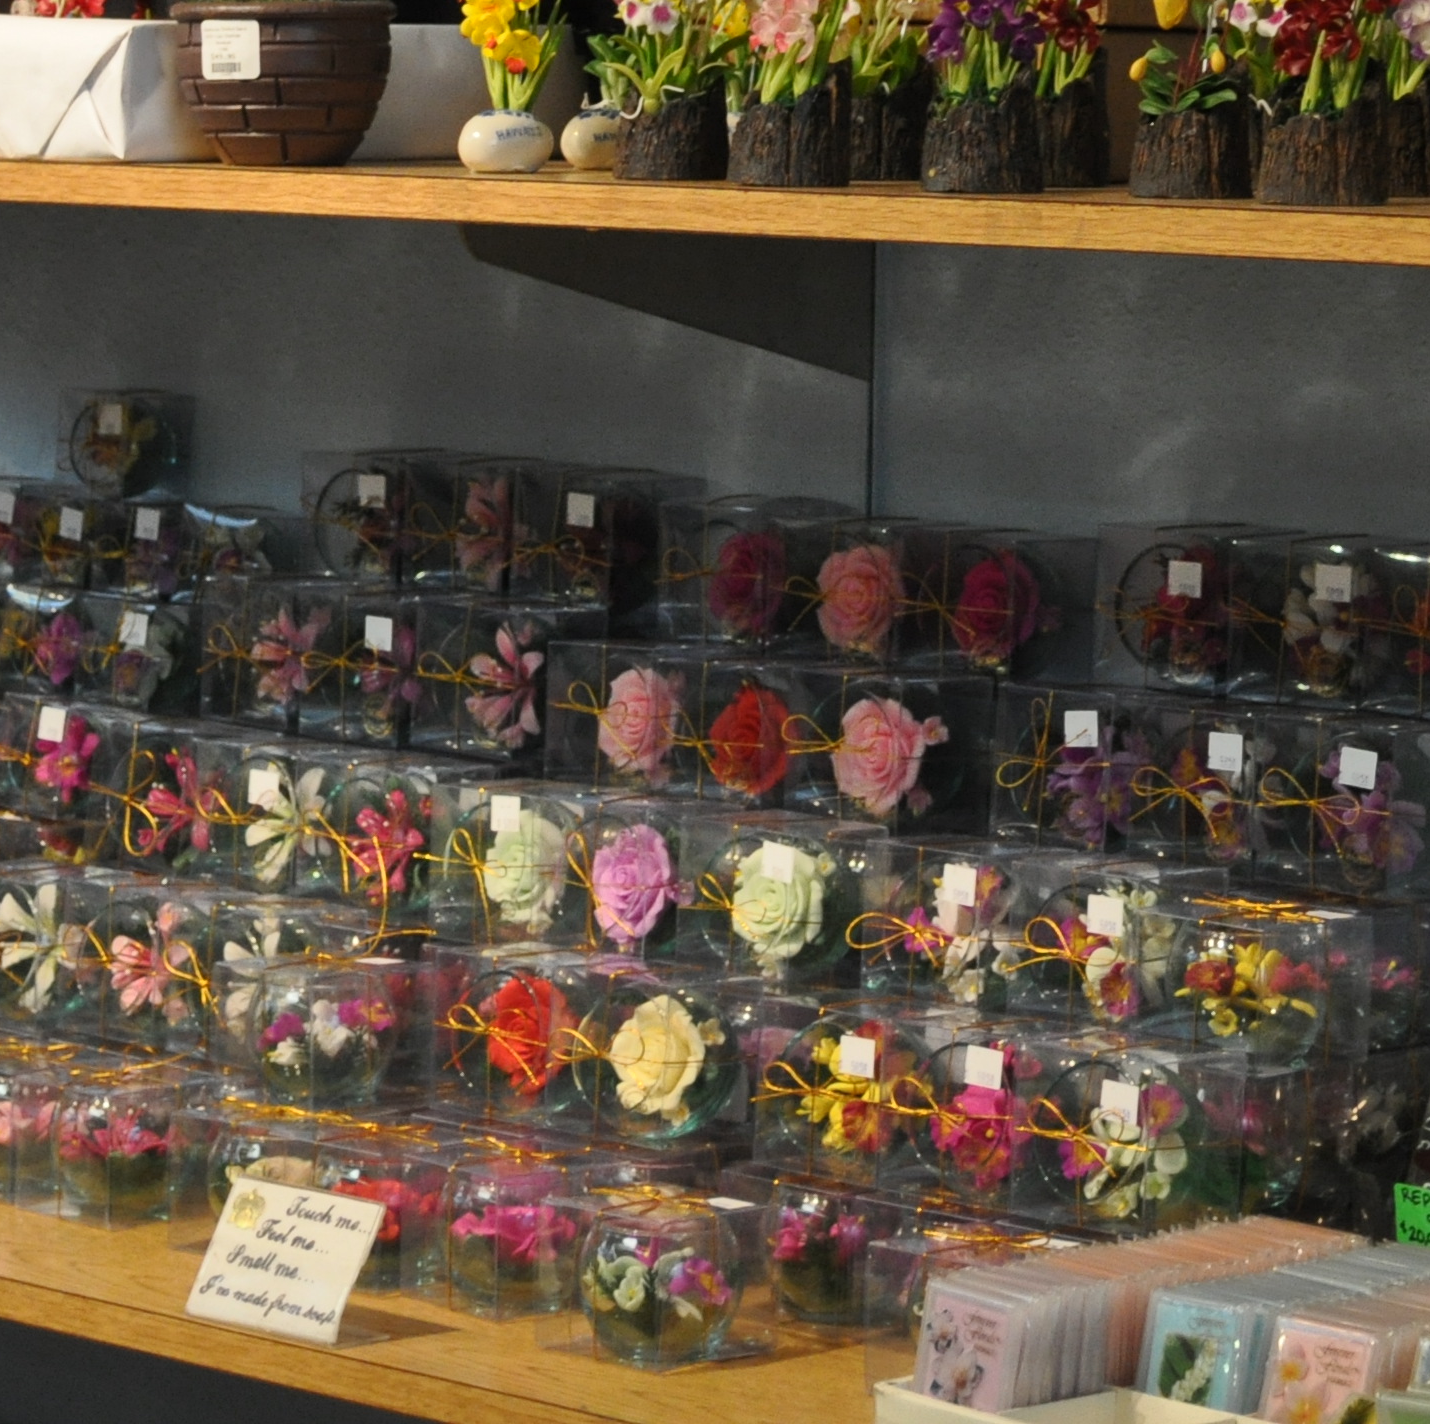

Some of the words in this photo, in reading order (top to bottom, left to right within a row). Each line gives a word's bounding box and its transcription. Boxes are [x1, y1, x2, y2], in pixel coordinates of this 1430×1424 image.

[285, 1194, 335, 1225] Touch
[255, 1217, 291, 1245] Feel
[225, 1243, 277, 1273] Smell
[232, 1288, 269, 1309] made
[264, 1293, 303, 1318] from
